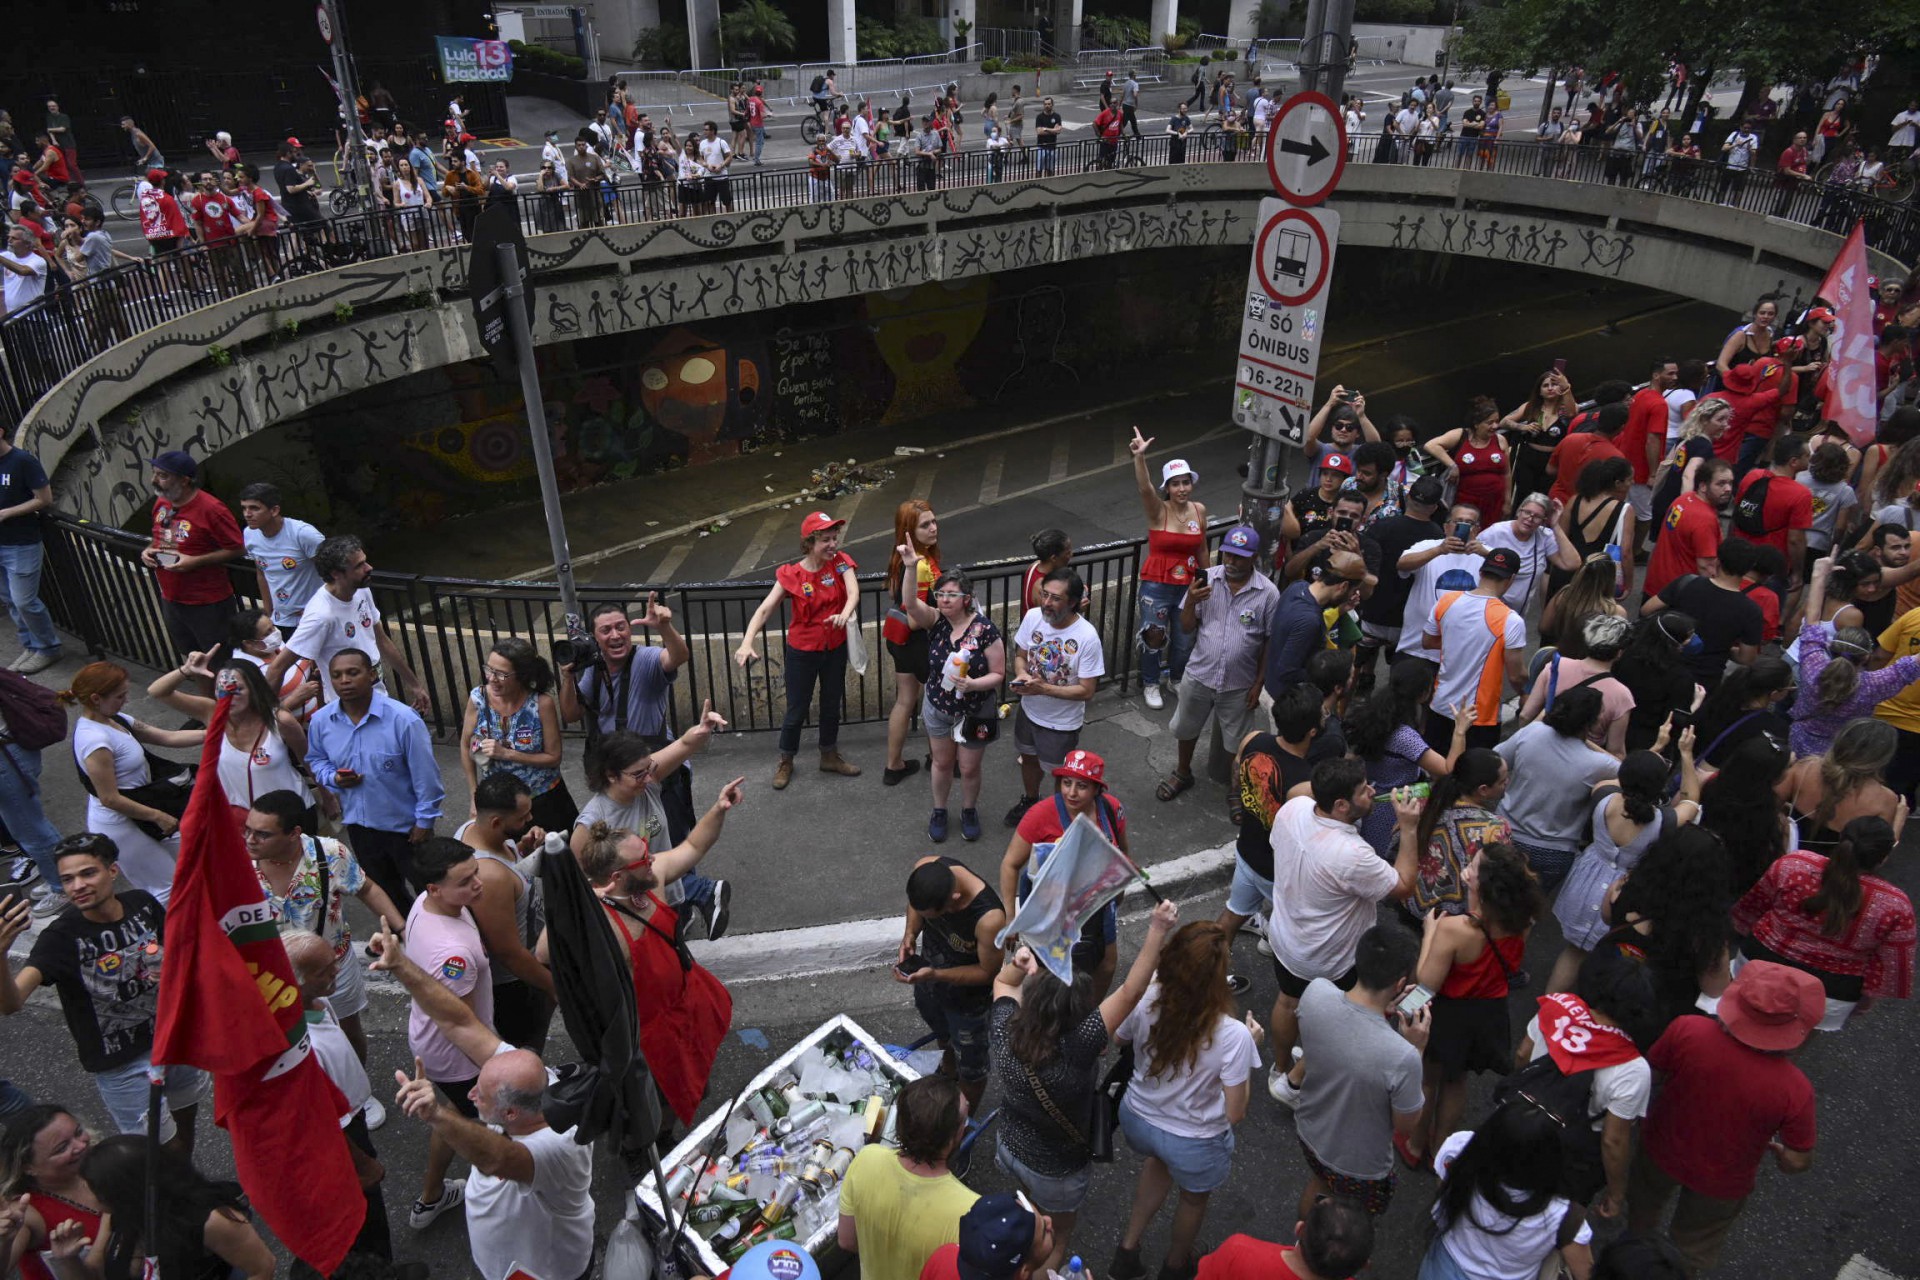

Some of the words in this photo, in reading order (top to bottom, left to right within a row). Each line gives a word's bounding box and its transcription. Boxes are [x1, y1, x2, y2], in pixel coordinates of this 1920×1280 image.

[537, 8, 565, 16] ENTRADA
[444, 47, 477, 61] Lula
[475, 41, 506, 66] 13
[446, 65, 507, 80] Haddad
[1270, 312, 1292, 334] SÓ
[1248, 328, 1310, 365] ÔNIBUS
[1068, 760, 1084, 770] LULA
[238, 906, 263, 924] DE
[98, 955, 121, 973] 13
[1551, 1015, 1593, 1053] 13
[772, 1259, 799, 1270] LULA
